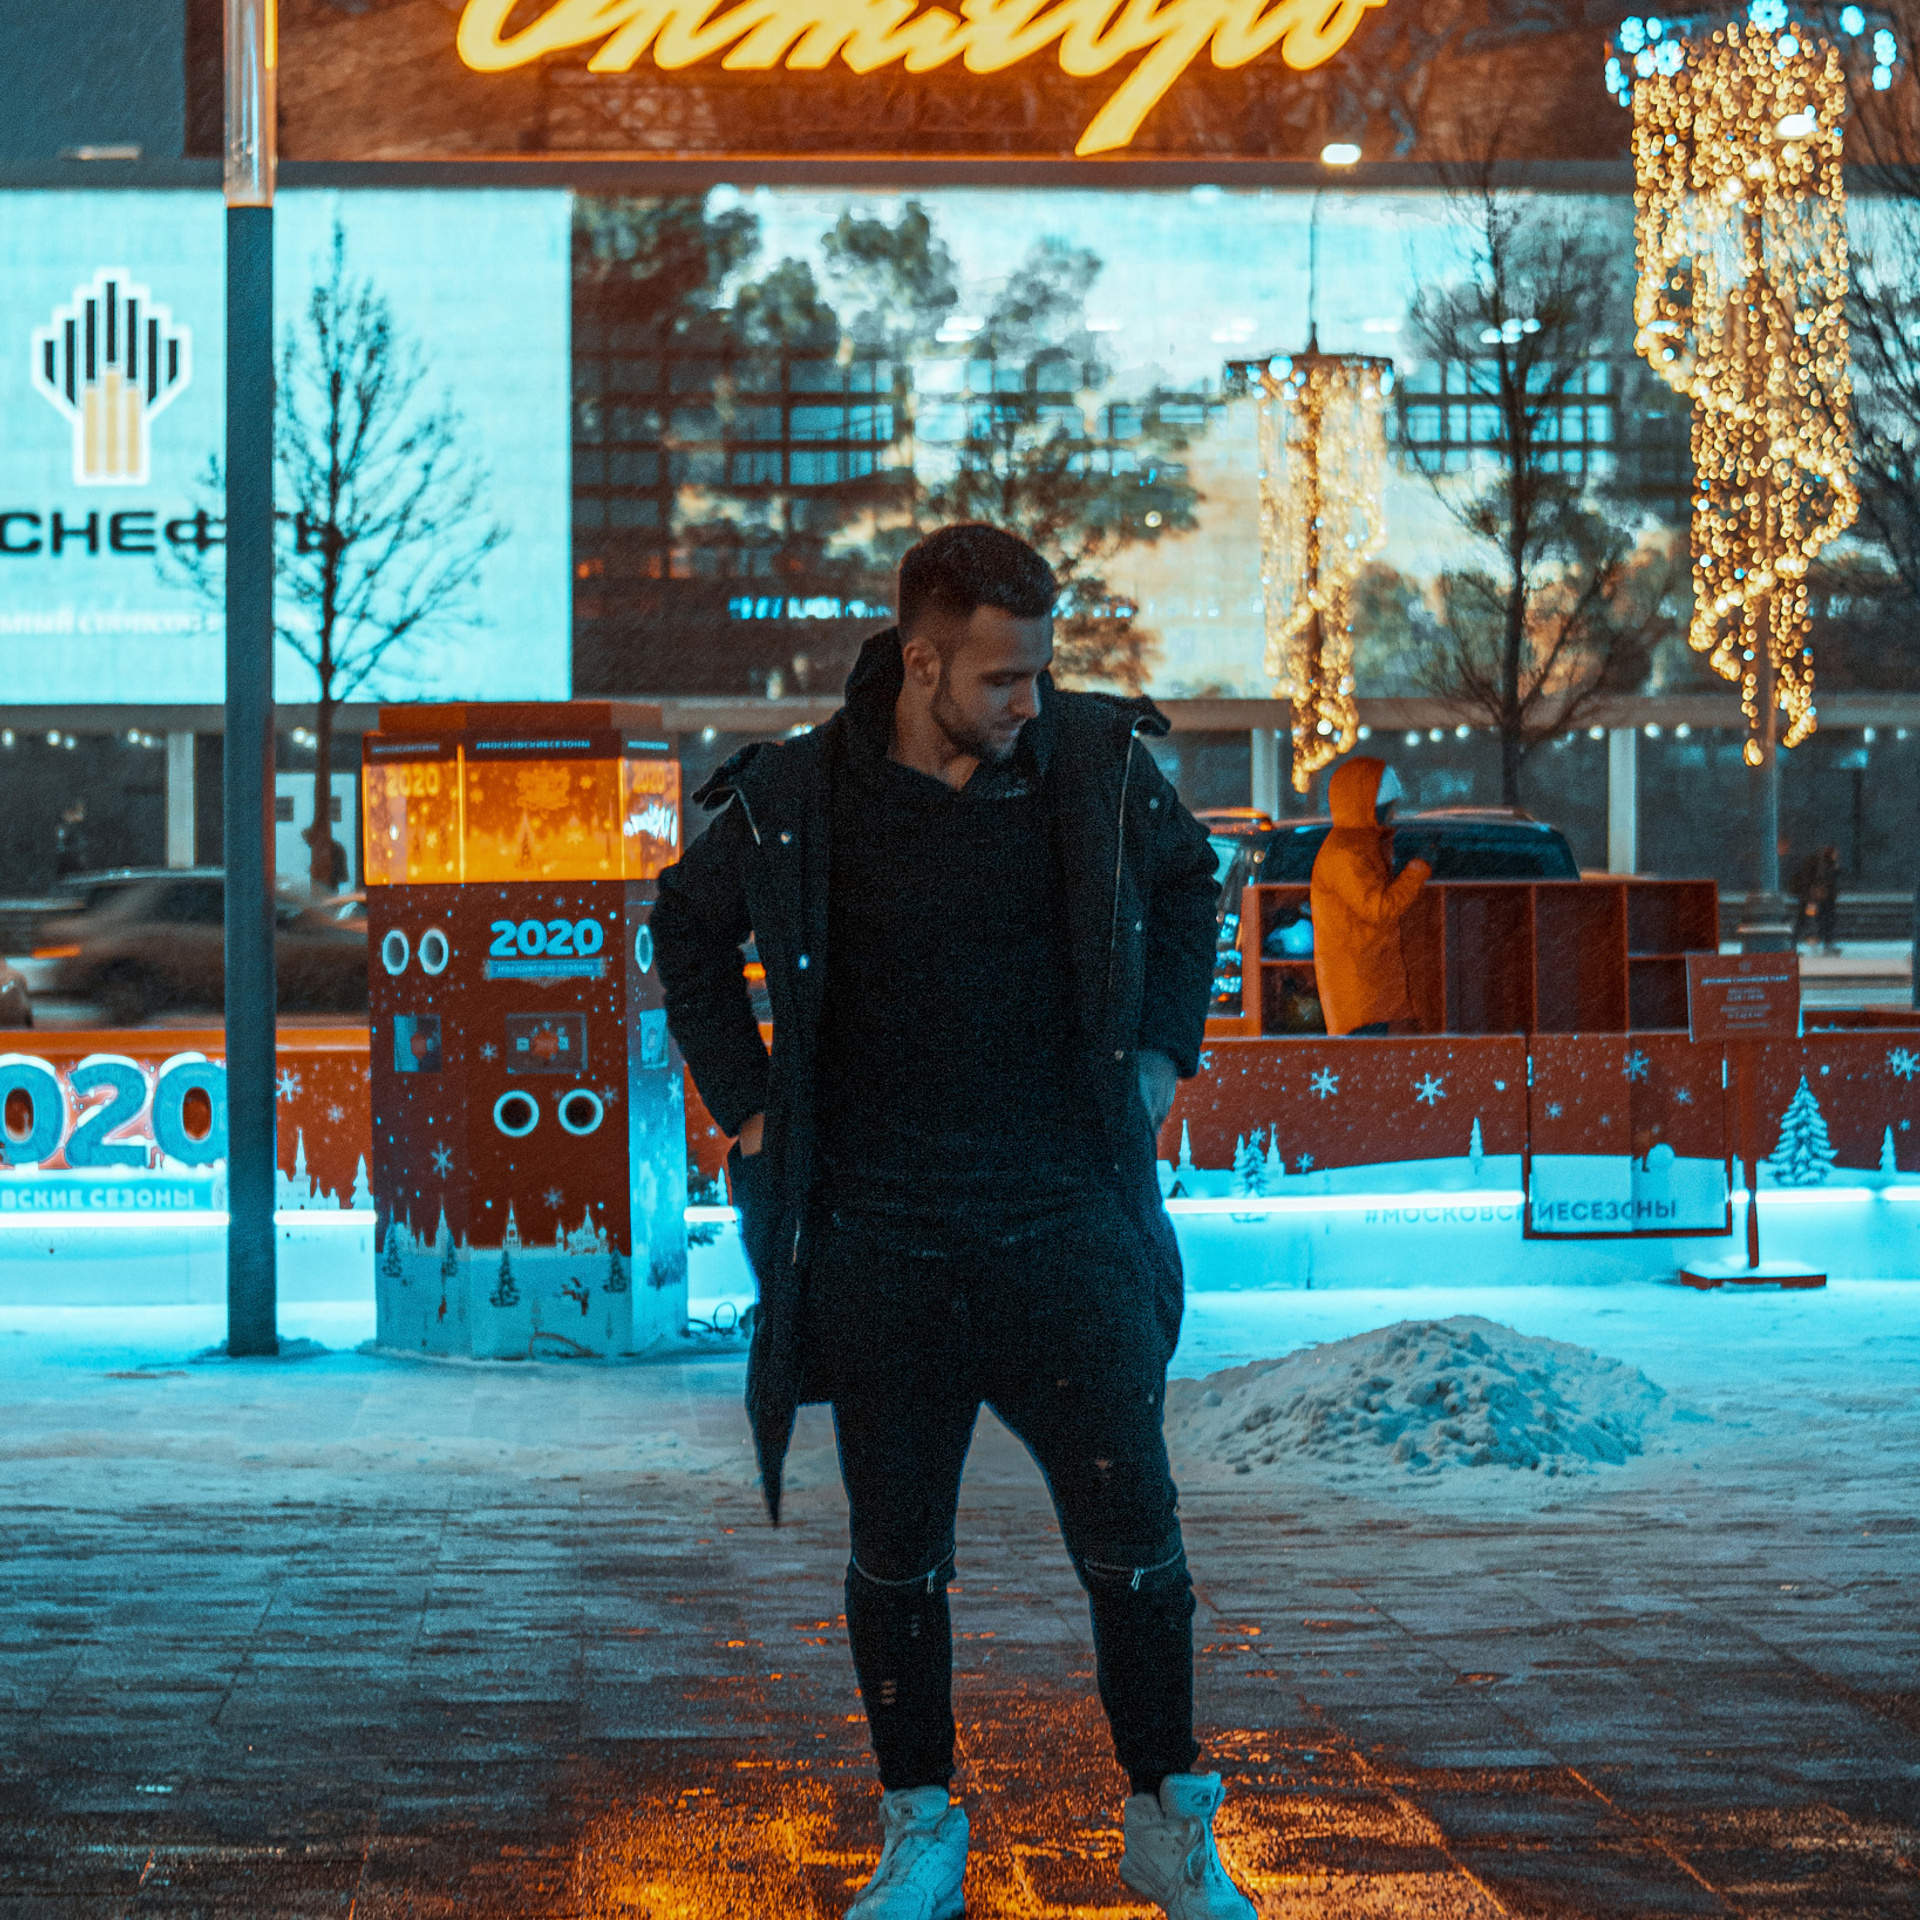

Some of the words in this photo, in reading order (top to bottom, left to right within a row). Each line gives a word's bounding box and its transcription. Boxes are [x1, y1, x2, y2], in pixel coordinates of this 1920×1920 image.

[385, 763, 439, 798] 2020
[489, 918, 604, 957] 2020
[89, 1188, 195, 1209] СЕЗОНЫ
